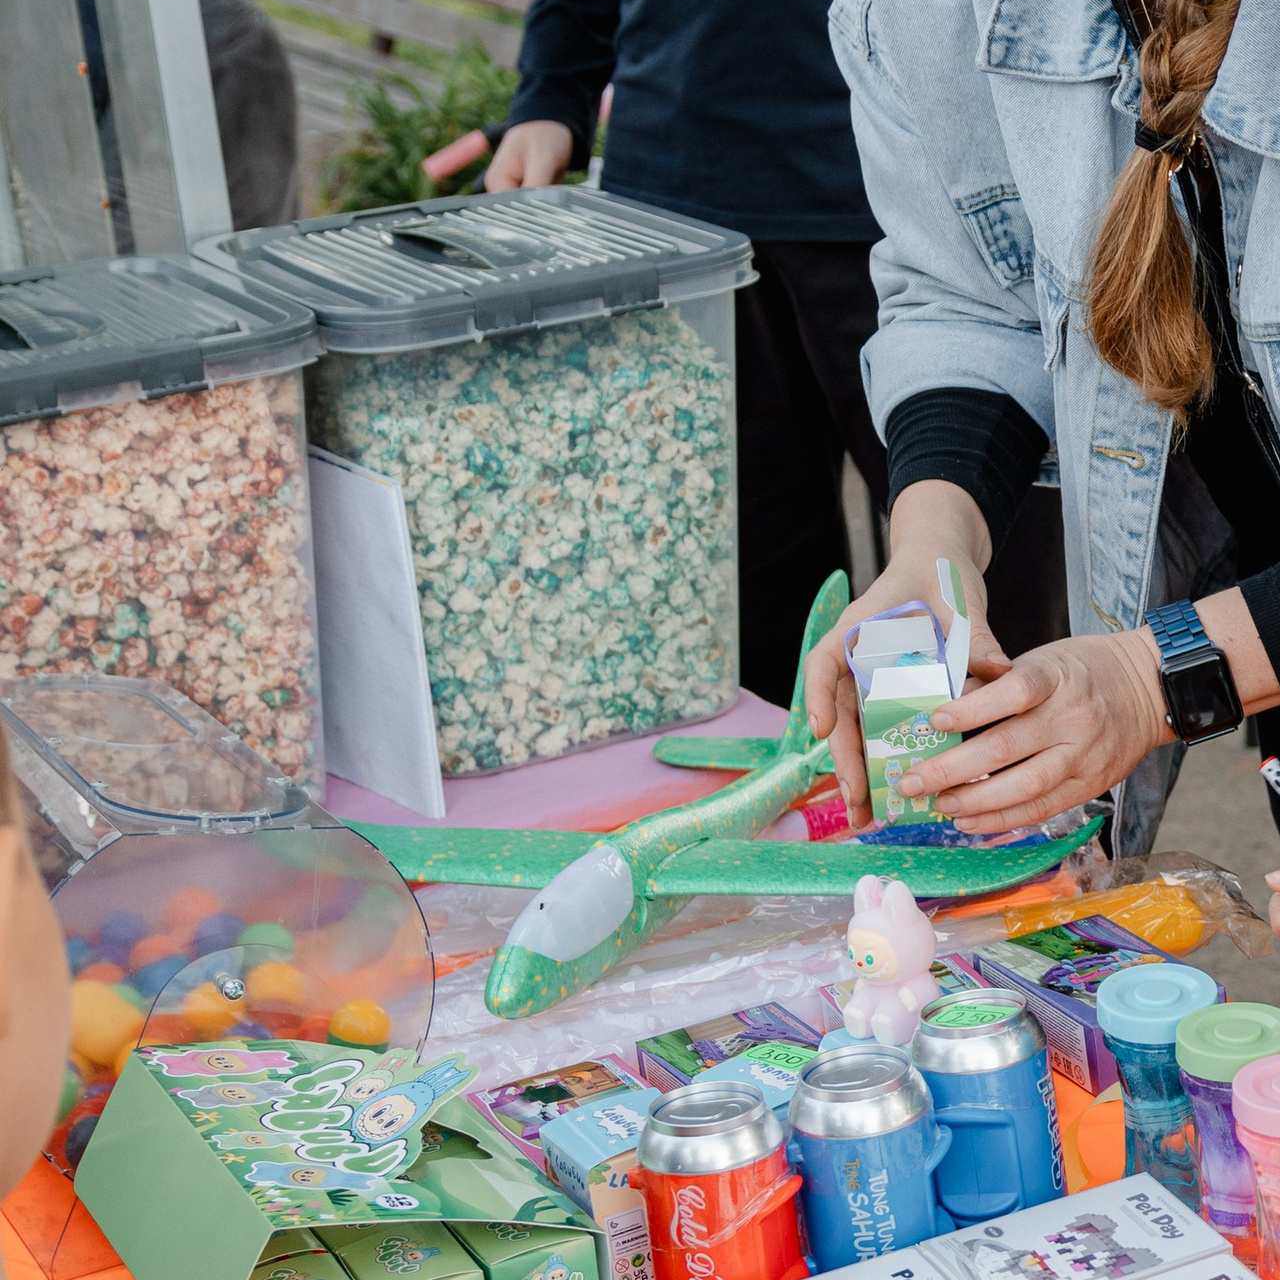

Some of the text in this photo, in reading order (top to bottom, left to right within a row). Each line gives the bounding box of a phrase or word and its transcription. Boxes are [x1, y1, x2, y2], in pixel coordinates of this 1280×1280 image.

[882, 728, 947, 751] LABUBU
[759, 1049, 804, 1064] 300
[260, 1059, 408, 1177] LABUBU
[845, 1158, 860, 1190] TUNG
[868, 1169, 889, 1216] TUNG
[676, 1185, 710, 1249] Cold
[1126, 1192, 1163, 1216] Pet
[1150, 1214, 1185, 1239] Day
[375, 1235, 421, 1275] LABUBU
